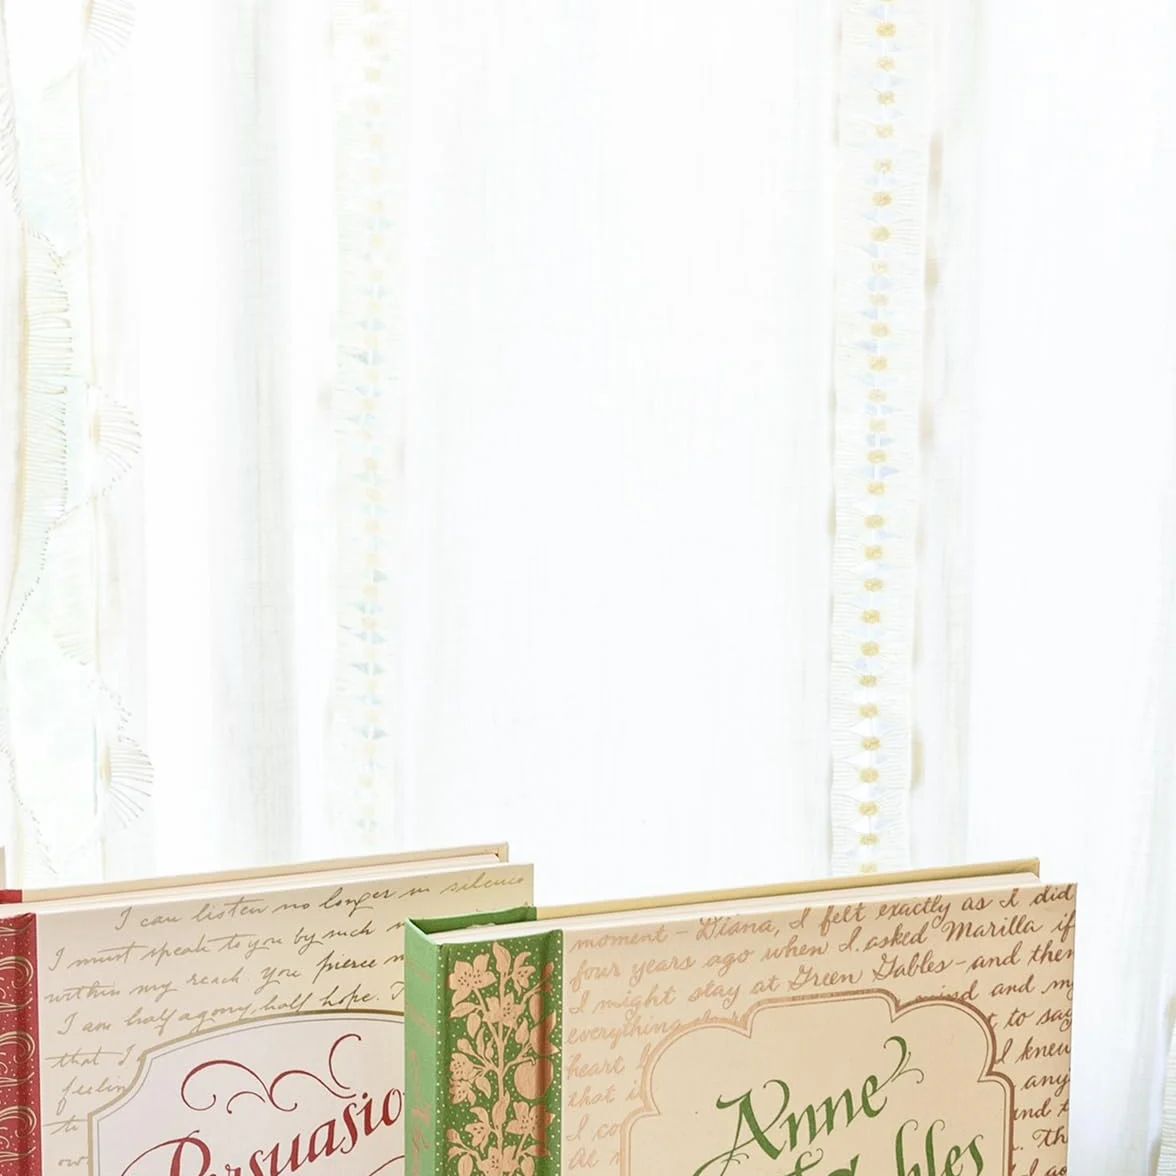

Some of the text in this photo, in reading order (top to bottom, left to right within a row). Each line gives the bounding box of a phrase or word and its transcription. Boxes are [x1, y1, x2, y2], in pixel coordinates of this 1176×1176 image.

[319, 887, 398, 917] longer
[819, 884, 1074, 936] felt exactly as I did
[941, 914, 1044, 942] Marilla
[788, 965, 864, 990] Green
